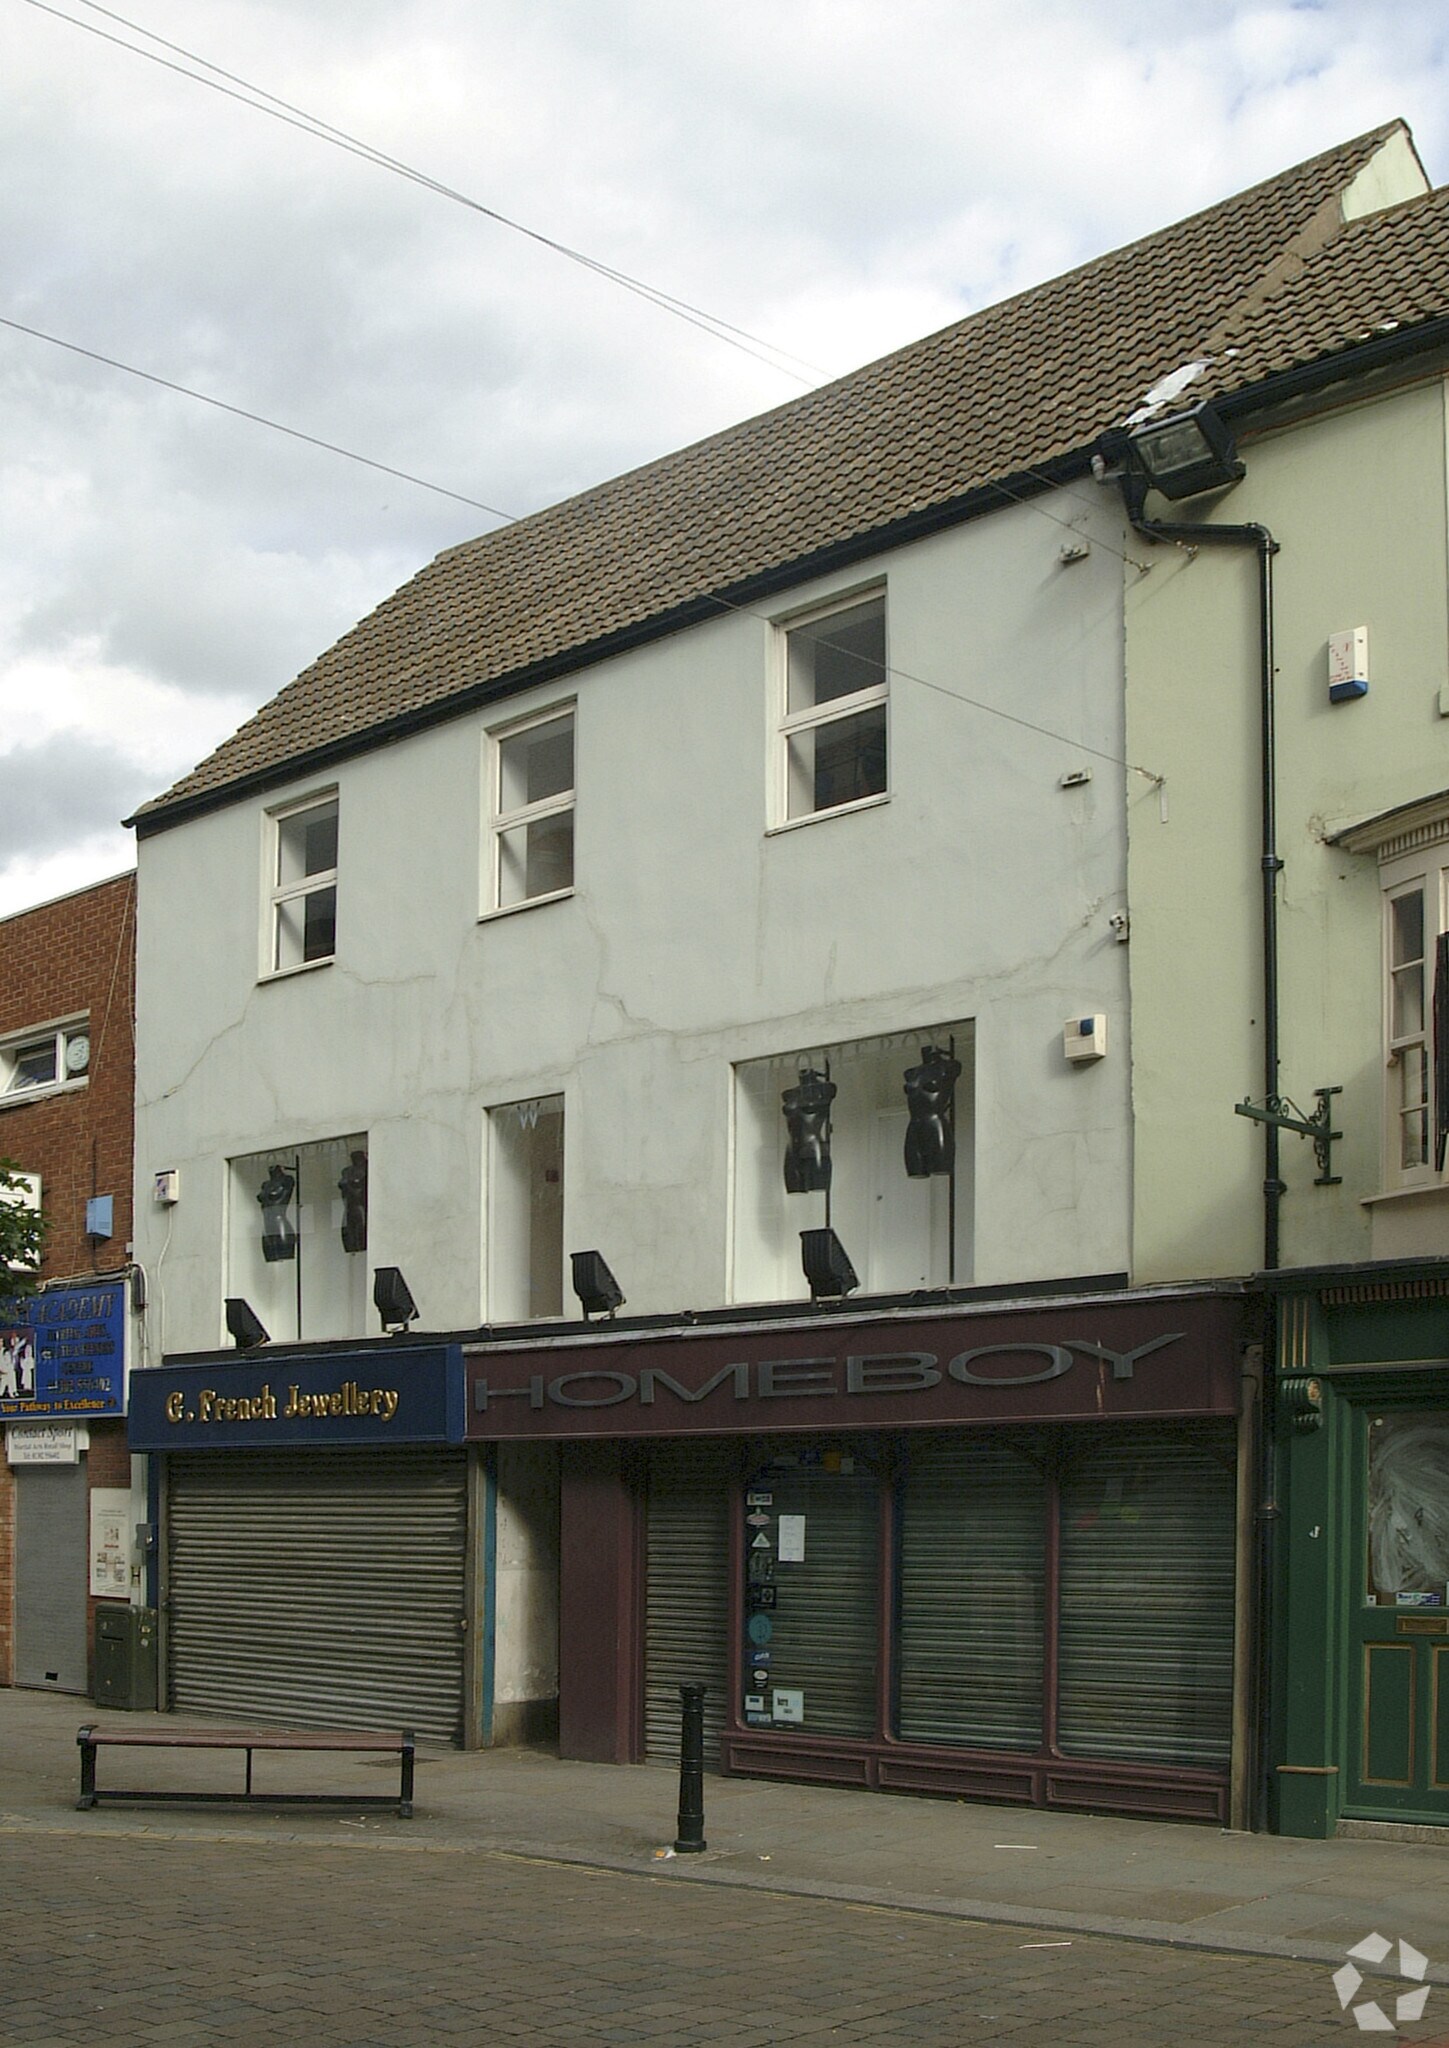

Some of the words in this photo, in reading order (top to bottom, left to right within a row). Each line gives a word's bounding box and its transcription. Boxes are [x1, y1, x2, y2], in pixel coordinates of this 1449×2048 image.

[38, 1293, 117, 1325] ACADEMY
[473, 1331, 1187, 1411] HOMEBOY
[63, 1398, 106, 1410] Excellence
[165, 1390, 195, 1424] G.
[198, 1383, 278, 1423] French
[283, 1380, 399, 1422] Jewellery
[46, 1423, 73, 1442] Sport
